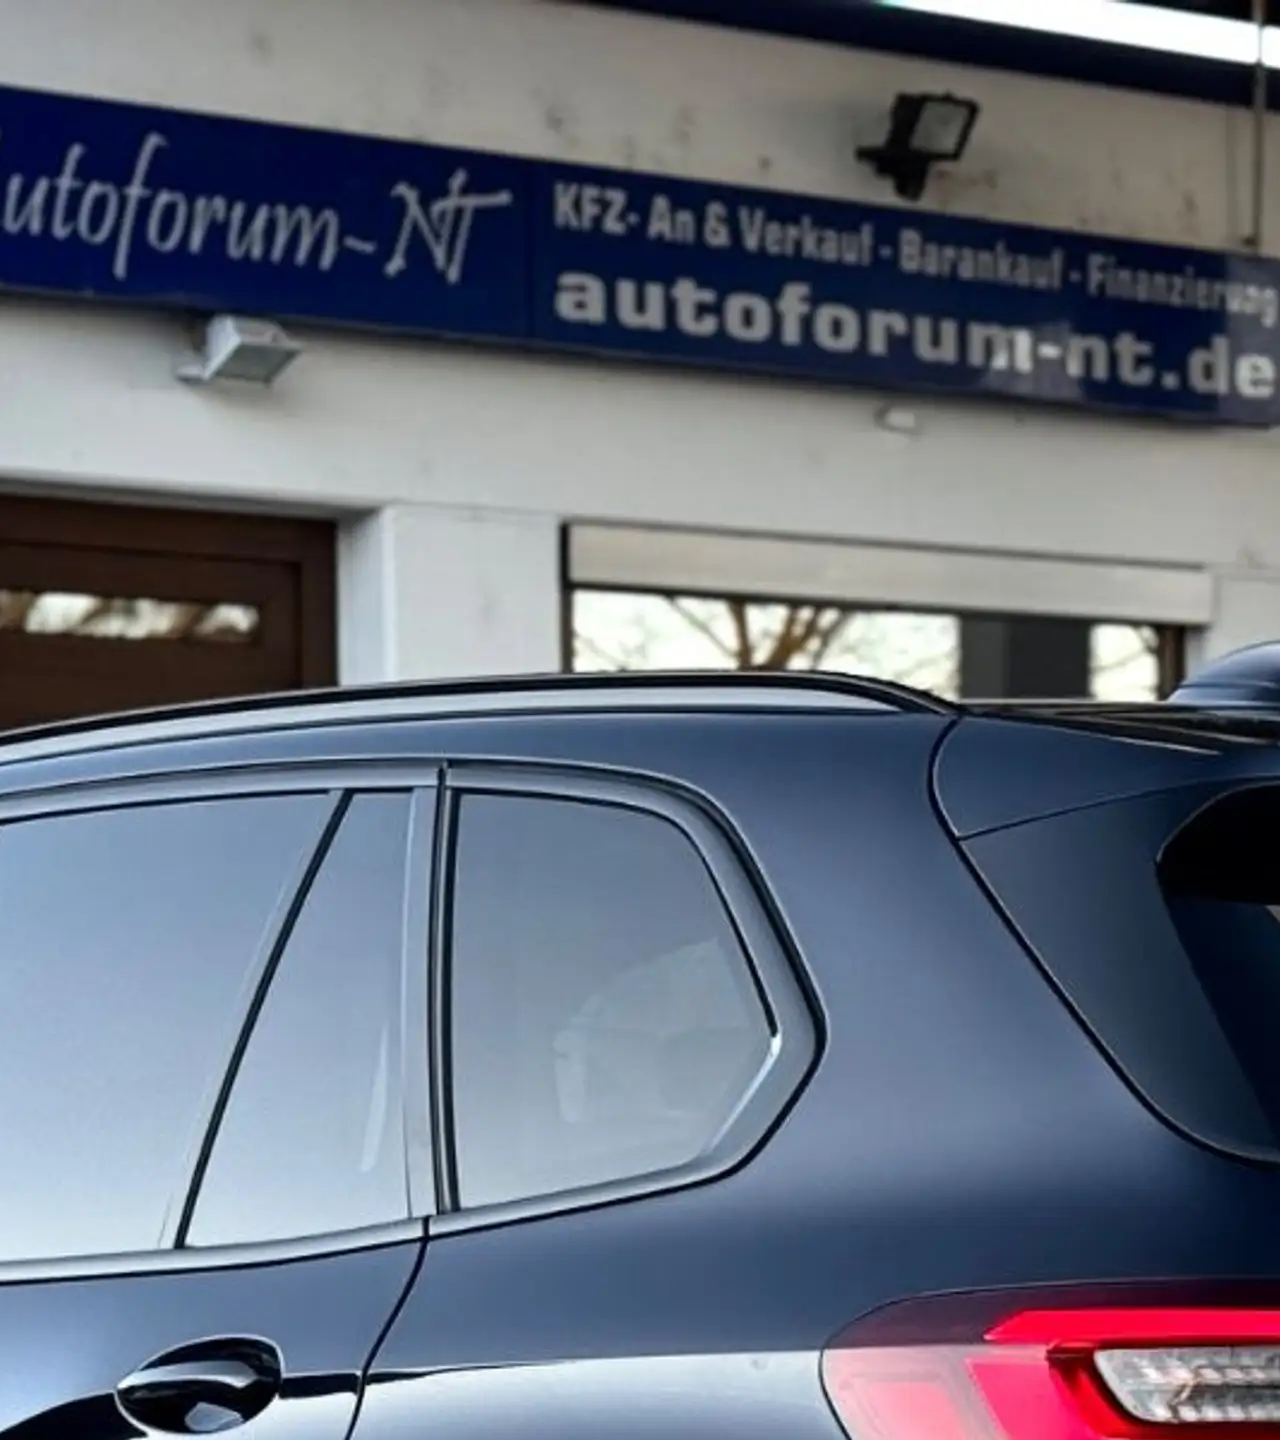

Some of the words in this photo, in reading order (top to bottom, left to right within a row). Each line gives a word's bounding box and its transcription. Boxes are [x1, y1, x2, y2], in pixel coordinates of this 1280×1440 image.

[648, 195, 695, 243] An
[703, 202, 729, 248] &
[738, 206, 875, 266] Verkauf
[899, 229, 1062, 288] Barankauf
[1088, 256, 1278, 328] Finanzierung
[554, 271, 1276, 398] autoforum-nt.de
